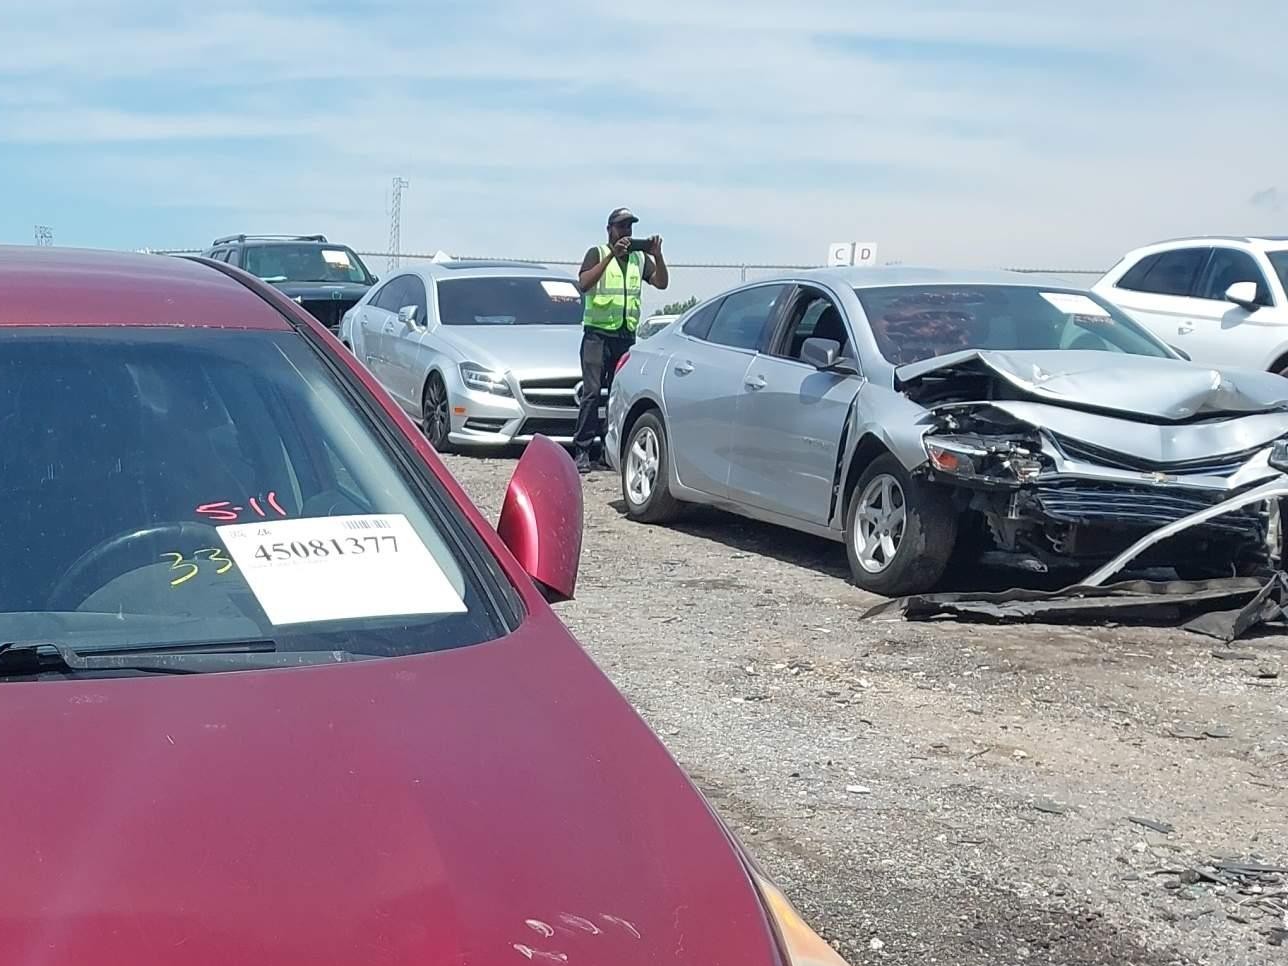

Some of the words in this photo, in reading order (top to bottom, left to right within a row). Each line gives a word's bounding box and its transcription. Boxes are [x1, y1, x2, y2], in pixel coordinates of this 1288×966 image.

[835, 248, 845, 260] C
[861, 248, 871, 260] D
[254, 535, 400, 562] 45081377
